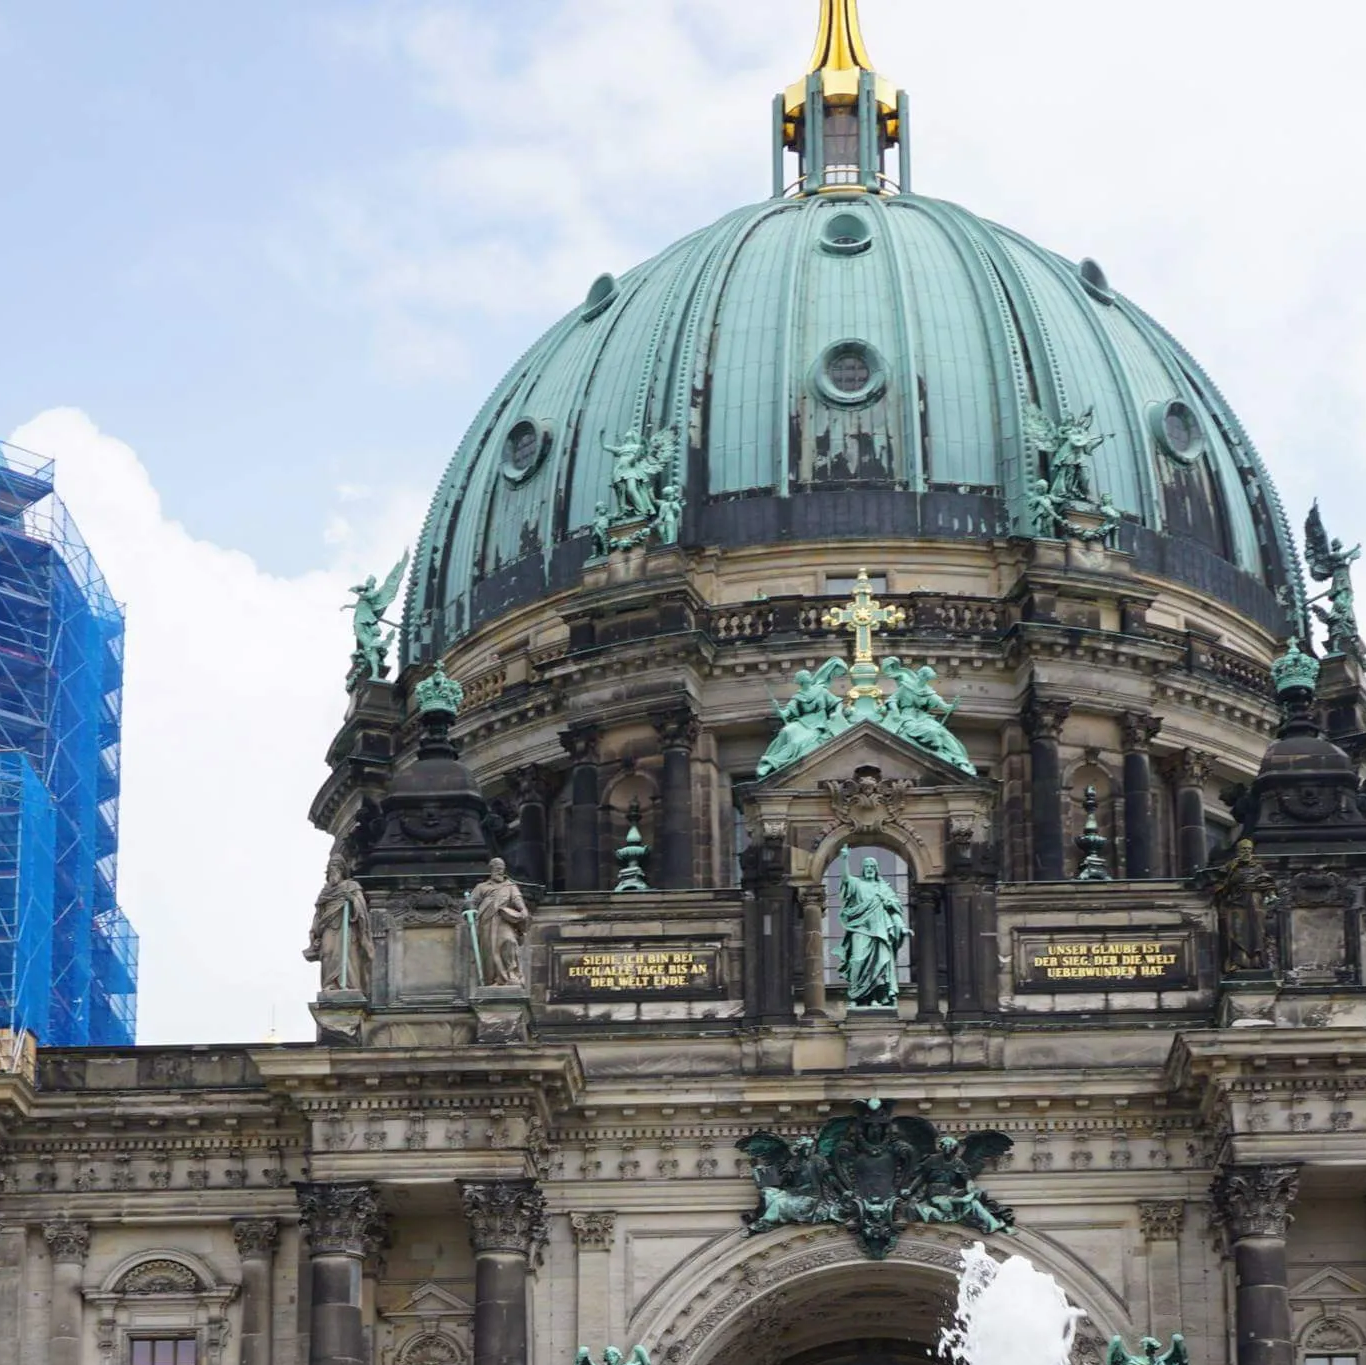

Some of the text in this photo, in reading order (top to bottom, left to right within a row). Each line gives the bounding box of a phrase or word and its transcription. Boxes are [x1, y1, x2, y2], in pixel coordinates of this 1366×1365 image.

[1048, 943, 1162, 955] UNSER GLAUBE IST
[623, 954, 644, 964] ICH
[648, 953, 670, 964] BIN
[673, 952, 693, 963] BEI
[1034, 957, 1058, 967] DER
[1094, 955, 1118, 966] DER
[1122, 955, 1143, 965] DIE
[1145, 954, 1176, 964] WELT
[569, 964, 707, 976] EUCH ALLE TAGE BIS AN
[1047, 966, 1137, 978] UEBERWUNDEN
[590, 977, 615, 988] DER
[619, 976, 650, 987] WELT
